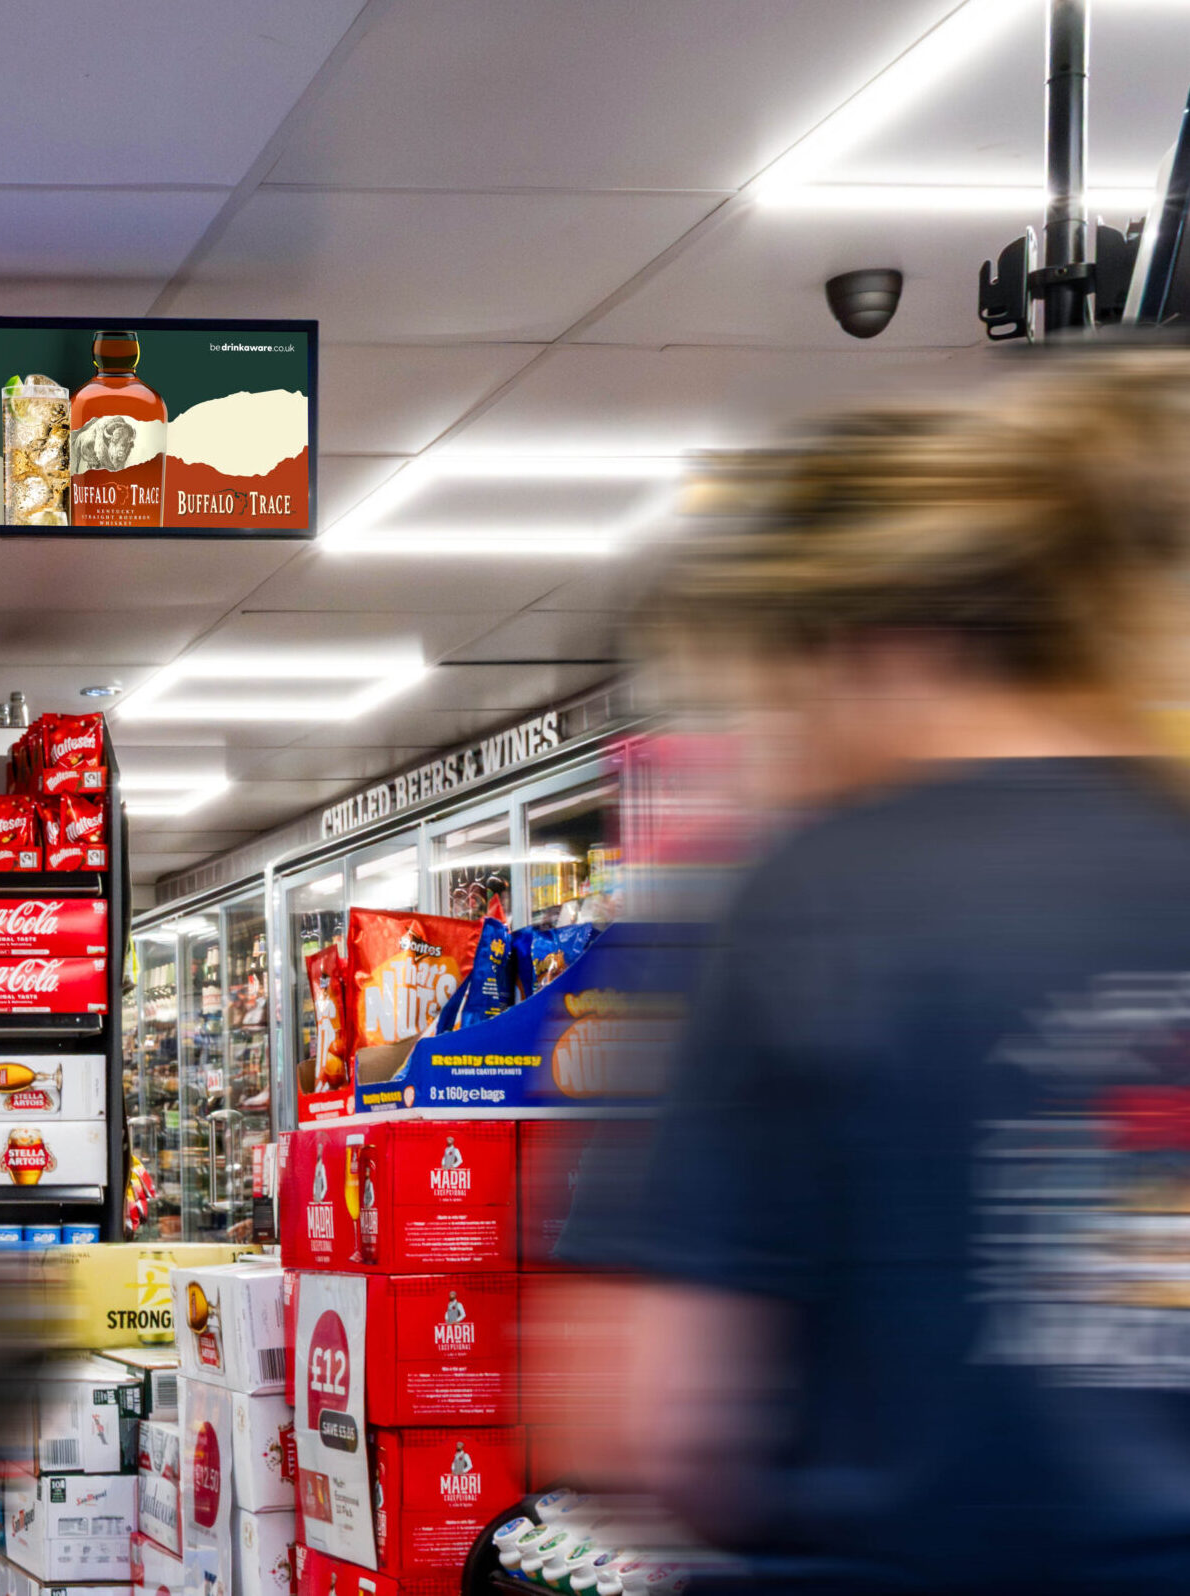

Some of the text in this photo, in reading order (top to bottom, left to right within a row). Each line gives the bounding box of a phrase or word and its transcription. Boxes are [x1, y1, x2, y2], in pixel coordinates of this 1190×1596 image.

[73, 483, 159, 506] BUFFALO TRACE
[178, 490, 291, 516] BUFFALO TRACE
[321, 711, 560, 840] CHILLED BEERS & WINES
[431, 1055, 542, 1067] Really Cheesy
[430, 1086, 437, 1100] 8
[438, 1089, 445, 1100] x
[481, 1087, 505, 1102] bags
[8, 1149, 45, 1157] STELLA
[107, 1309, 174, 1329] STRONG
[311, 1347, 346, 1395] £12
[322, 1421, 339, 1437] SAVE
